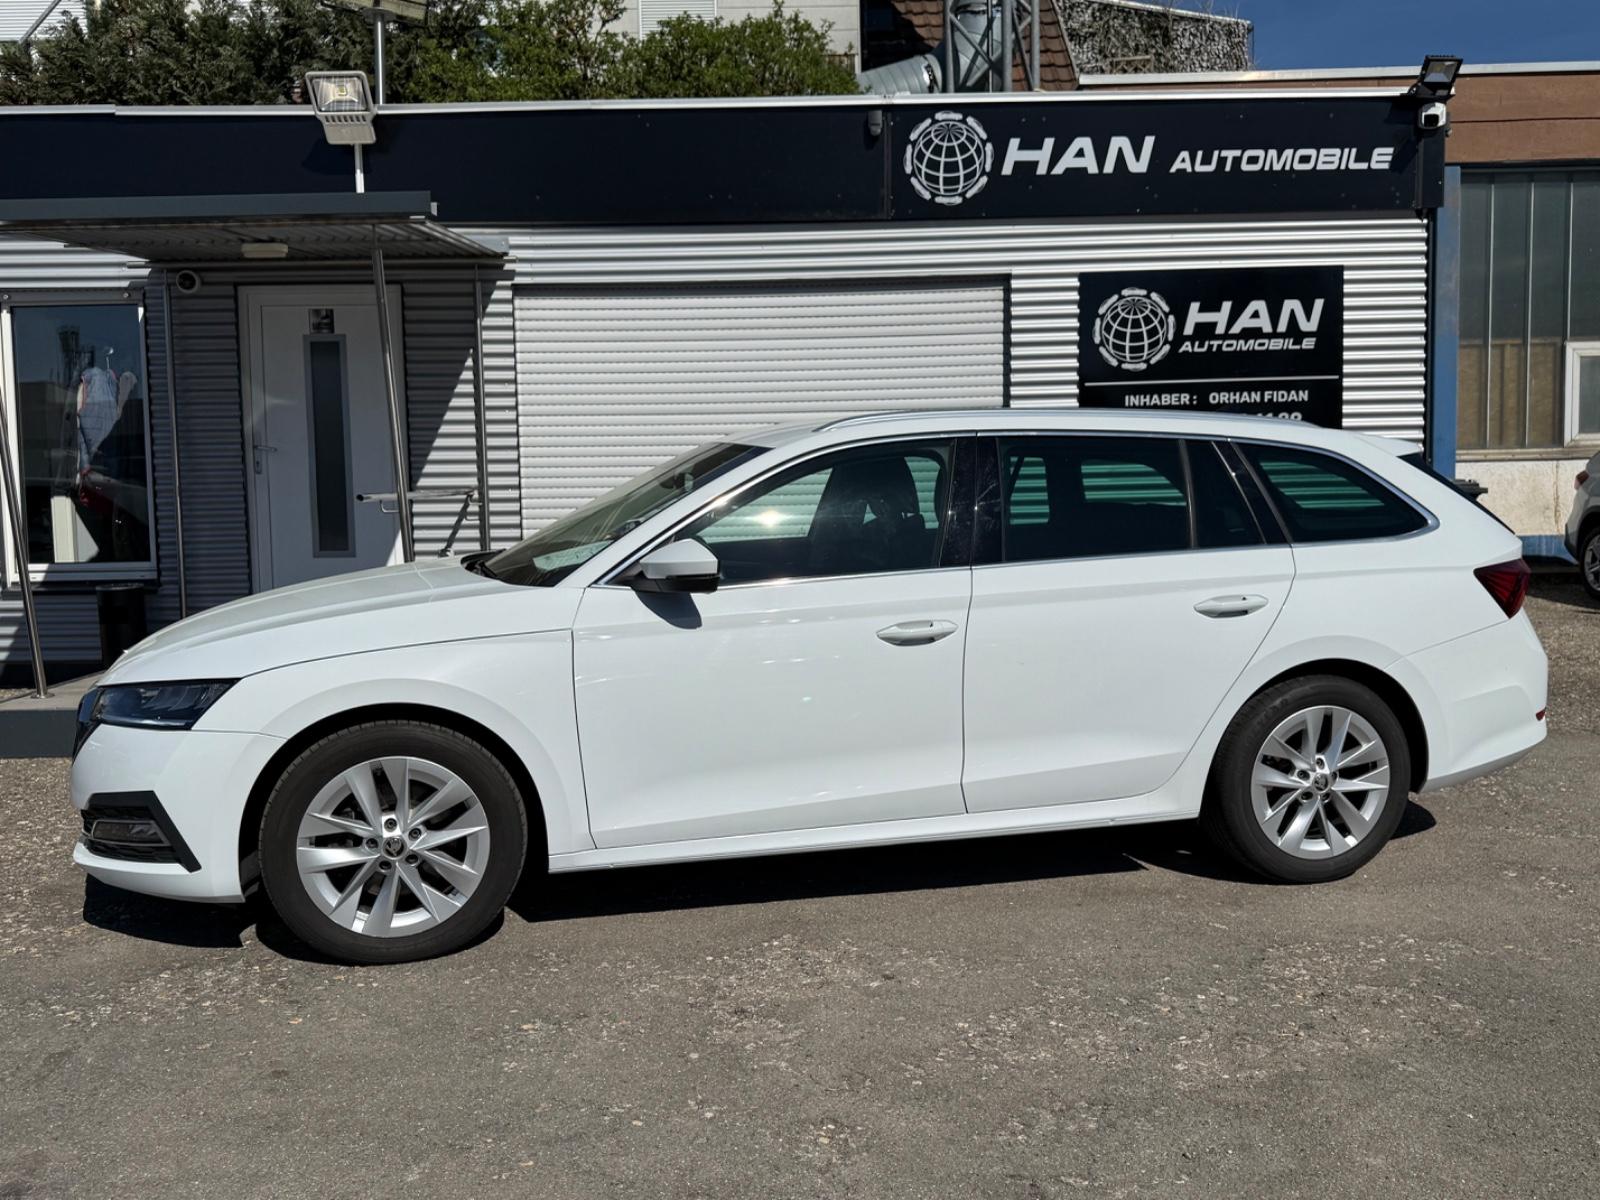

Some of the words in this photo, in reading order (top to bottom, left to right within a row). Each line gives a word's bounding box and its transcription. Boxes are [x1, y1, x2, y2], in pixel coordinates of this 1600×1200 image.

[1001, 136, 1156, 176] HAN
[1169, 146, 1395, 174] AUTOMOBILE
[1182, 298, 1325, 336] HAN
[1178, 337, 1317, 353] AUTOMOBILE
[1208, 391, 1261, 404] ORHAN
[1264, 389, 1309, 403] FIDAN
